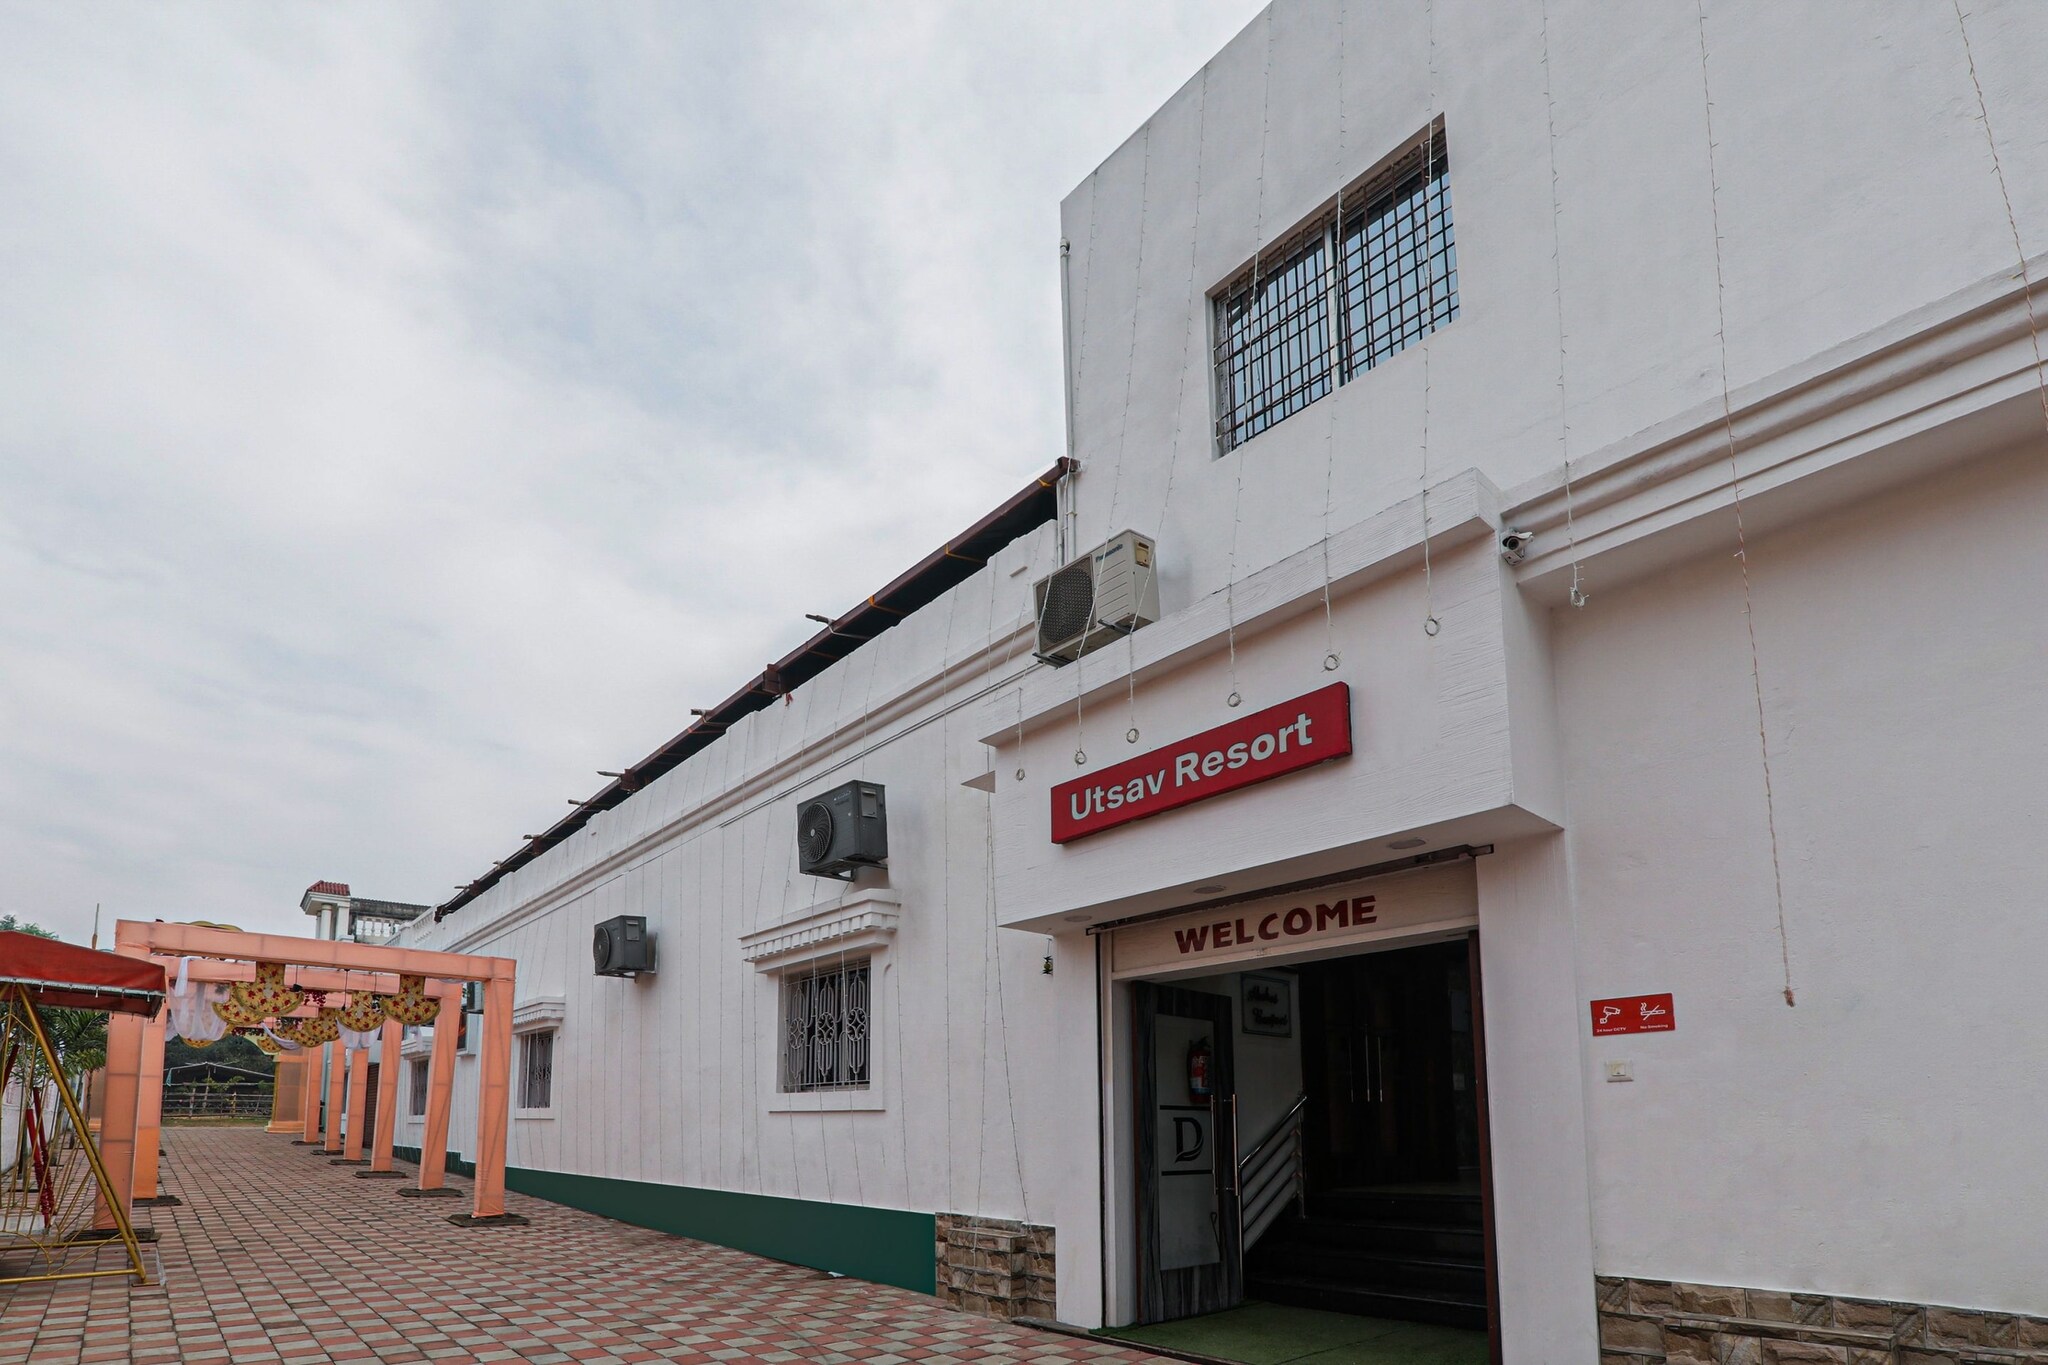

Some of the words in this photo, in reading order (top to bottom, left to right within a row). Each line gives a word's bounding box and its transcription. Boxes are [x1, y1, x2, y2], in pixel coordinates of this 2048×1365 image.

[1070, 769, 1166, 821] Utsav
[1174, 712, 1313, 788] Resort
[1174, 895, 1378, 954] WELCOME
